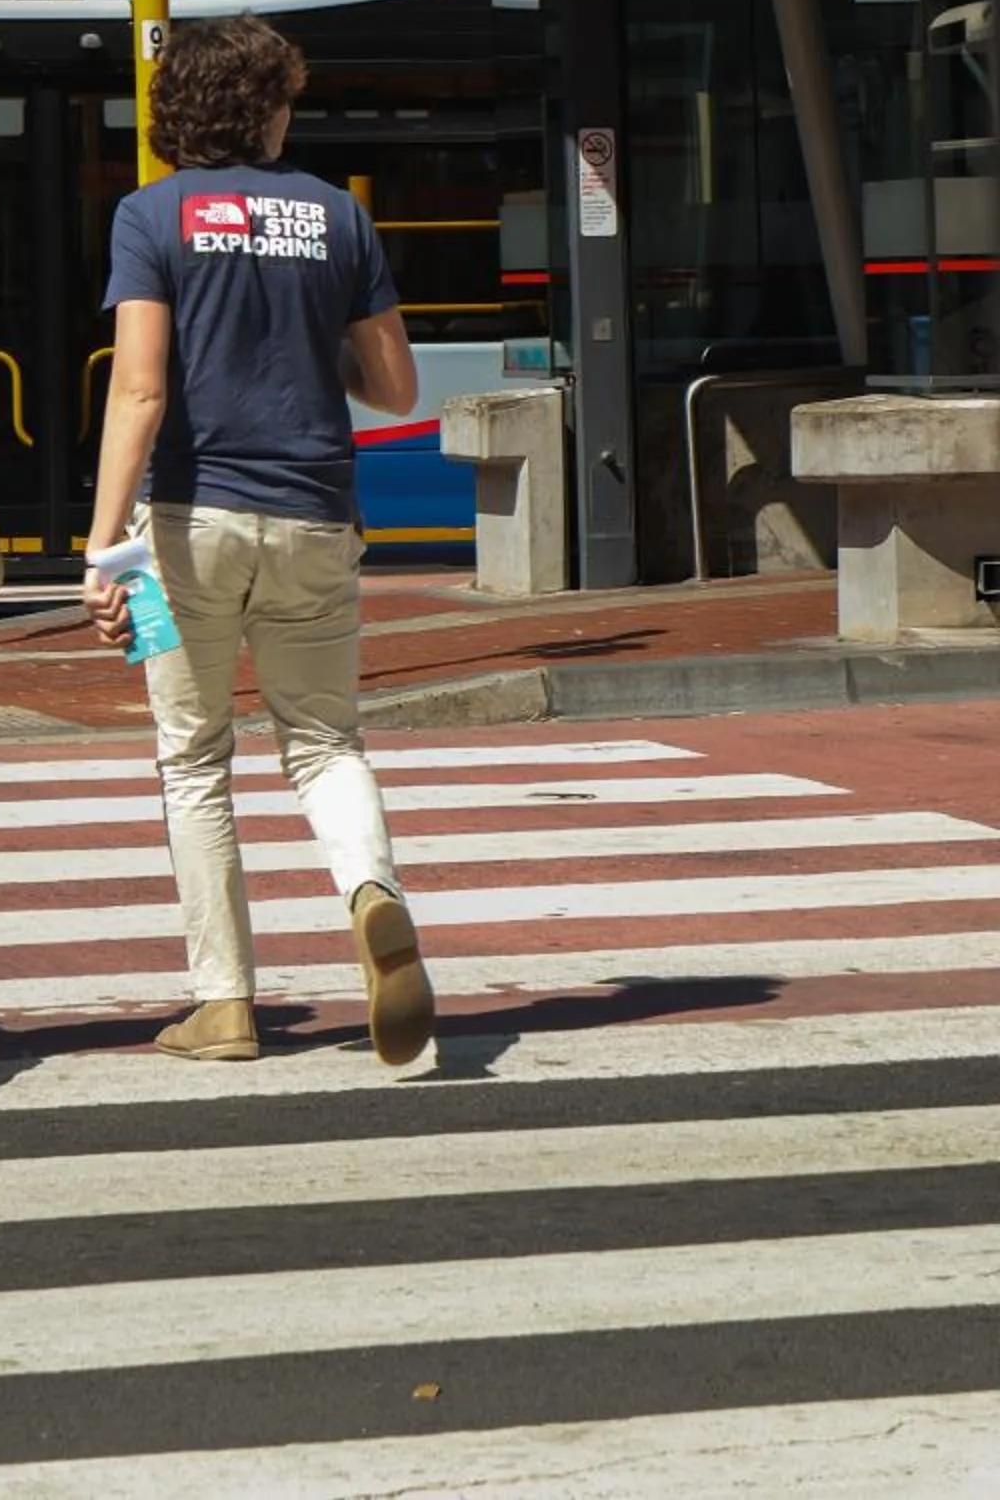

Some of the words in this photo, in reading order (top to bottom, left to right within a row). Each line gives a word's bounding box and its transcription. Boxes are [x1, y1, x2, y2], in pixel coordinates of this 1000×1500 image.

[245, 196, 326, 221] NEVER
[264, 217, 327, 239] STOP
[192, 232, 328, 261] EXPLORING
